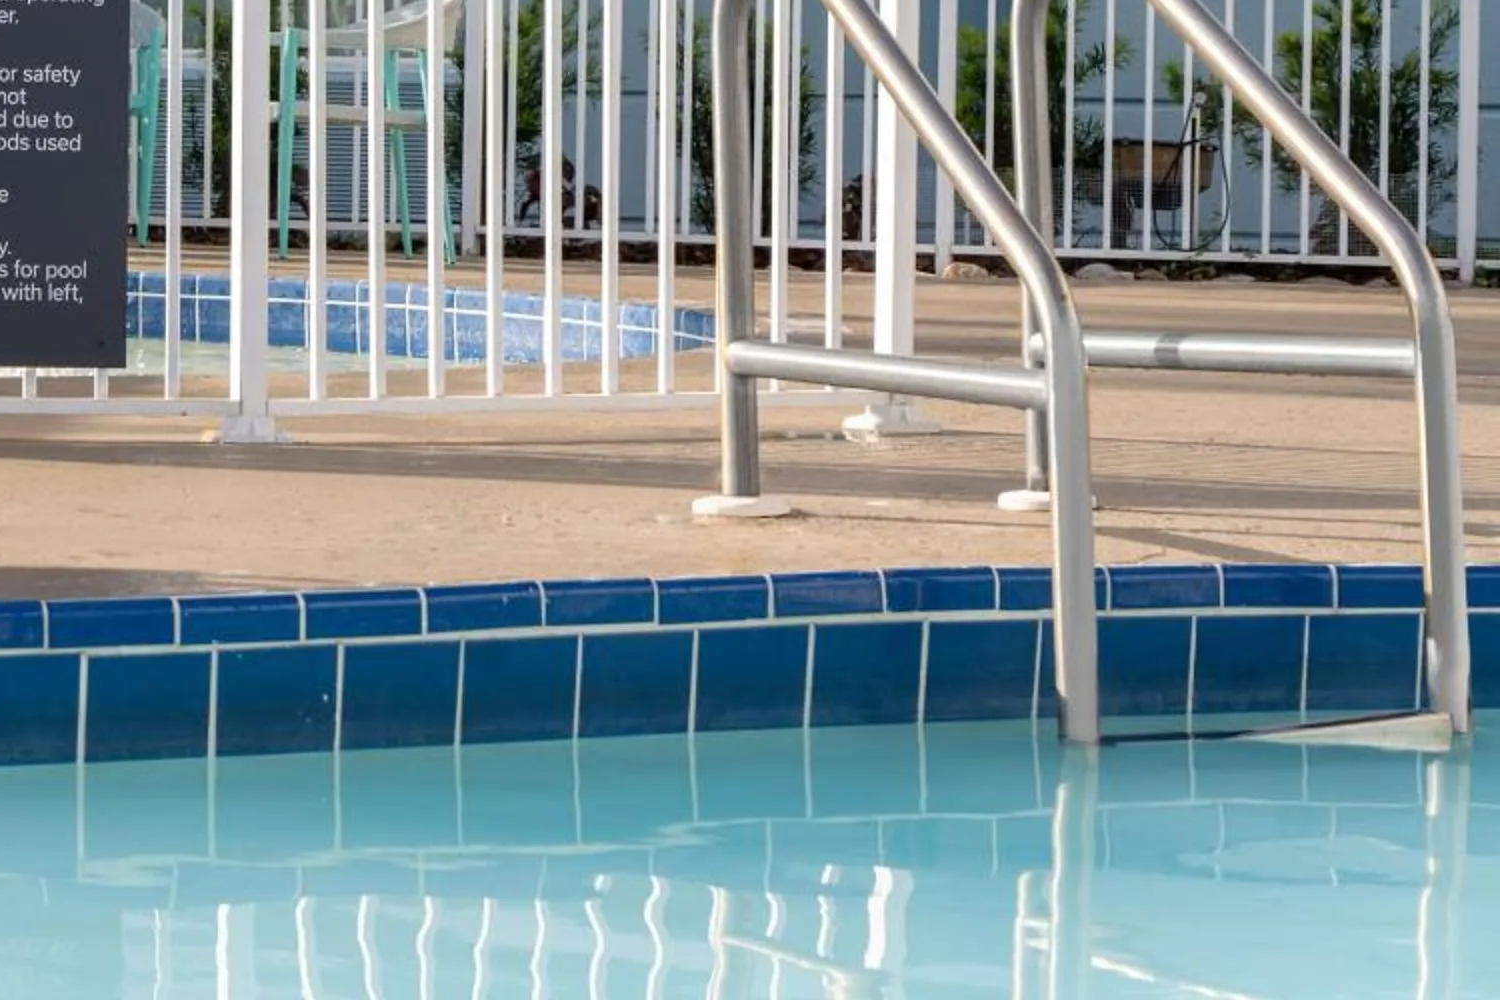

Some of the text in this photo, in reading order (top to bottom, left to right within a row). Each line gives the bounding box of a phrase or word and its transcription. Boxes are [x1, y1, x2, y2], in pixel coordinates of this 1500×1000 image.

[22, 63, 82, 88] safety
[12, 109, 50, 129] due
[53, 111, 74, 130] to
[34, 133, 82, 152] used
[13, 258, 41, 279] for
[45, 260, 87, 282] pool
[1, 281, 43, 302] with
[47, 282, 83, 304] left,
